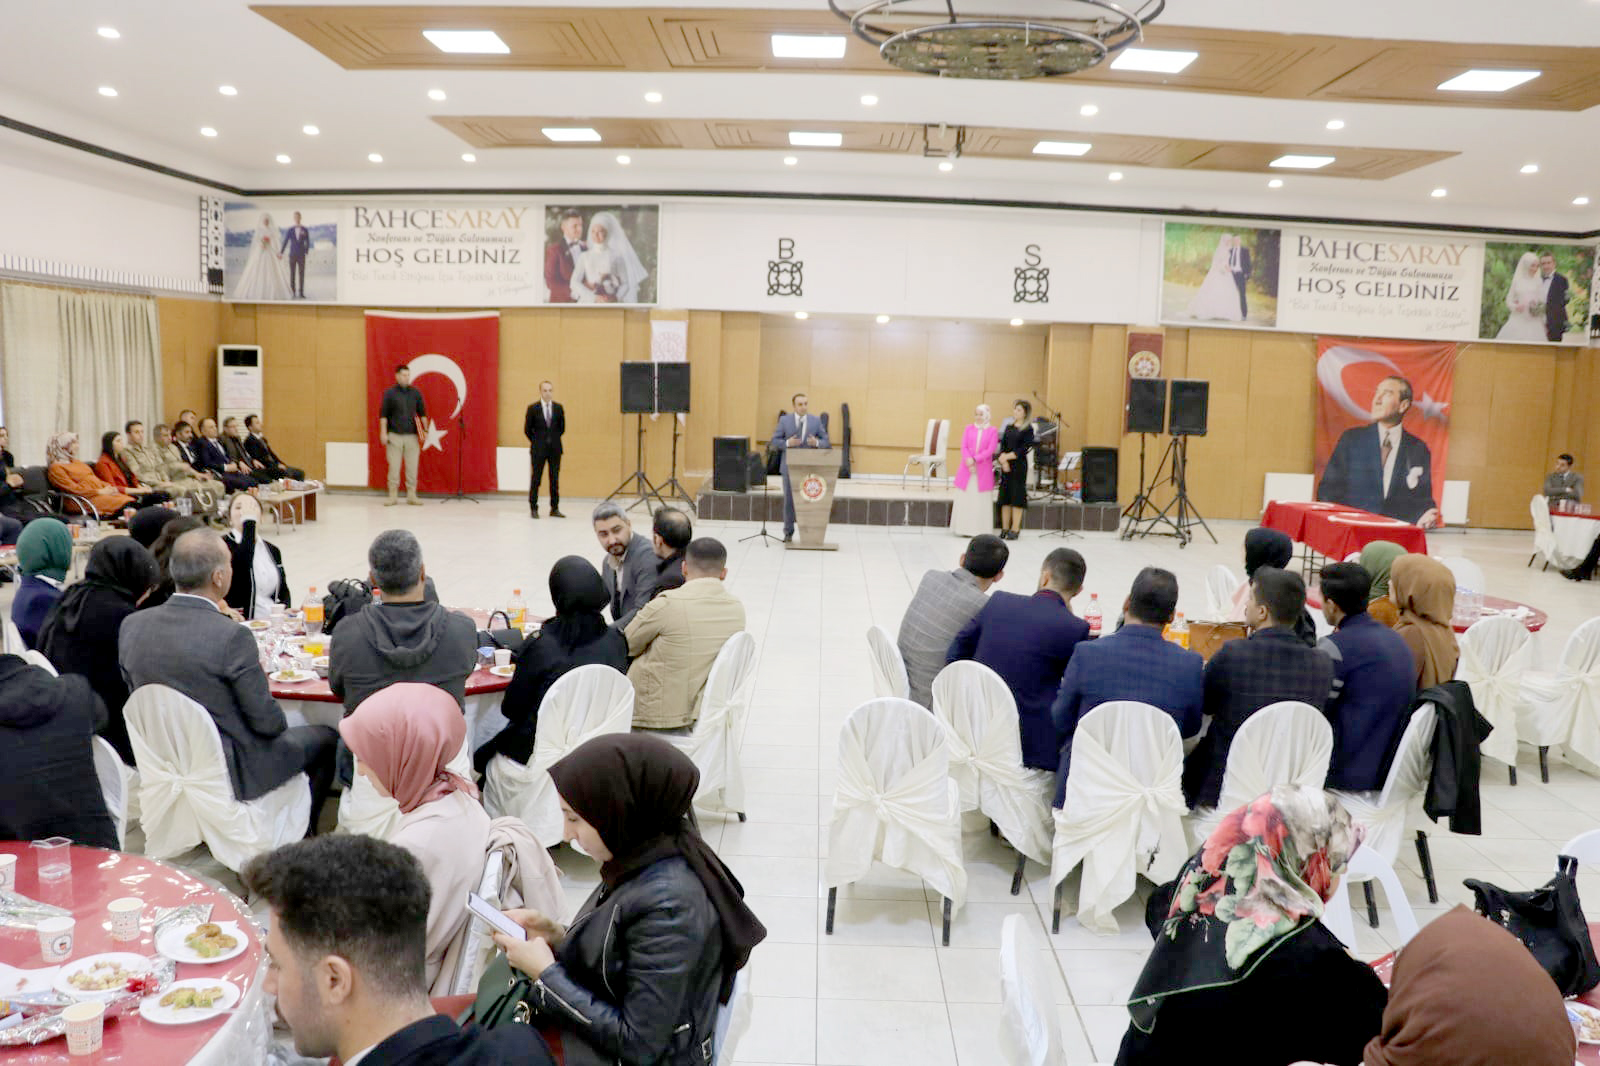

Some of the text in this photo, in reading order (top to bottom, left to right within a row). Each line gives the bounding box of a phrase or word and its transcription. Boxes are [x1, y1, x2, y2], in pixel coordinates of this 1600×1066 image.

[355, 245, 521, 268] HOŞ GELDİNİZ
[778, 238, 795, 260] B
[1024, 244, 1041, 267] S
[1297, 277, 1459, 301] HOŞ GELDİNİZ
